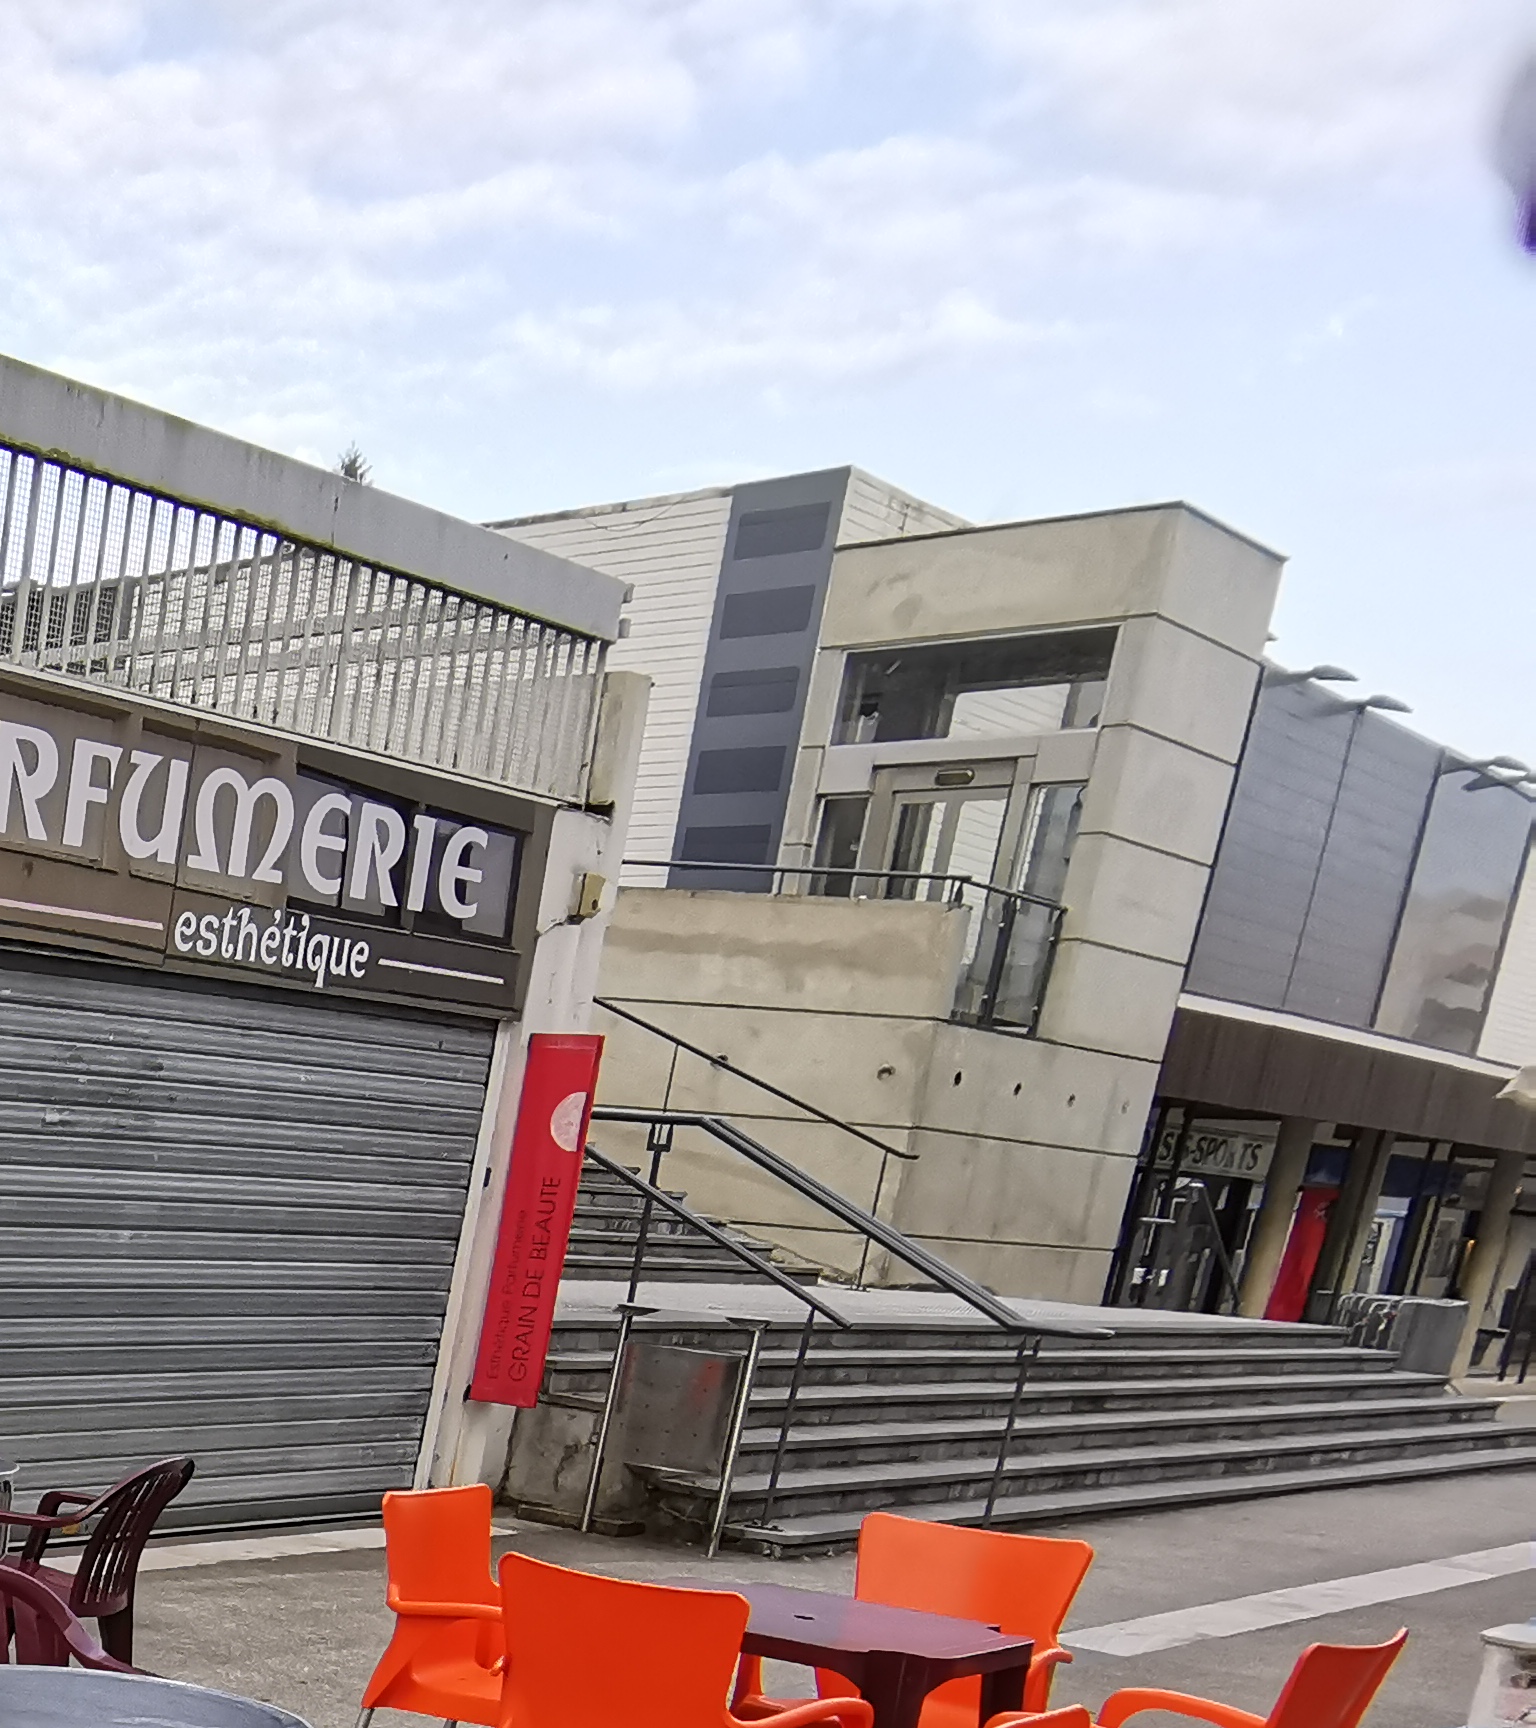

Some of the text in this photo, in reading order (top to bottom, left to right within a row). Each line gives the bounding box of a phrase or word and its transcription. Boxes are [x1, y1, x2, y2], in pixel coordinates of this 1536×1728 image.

[173, 906, 371, 987] esthétique
[507, 1176, 560, 1383] GRAIN DE BEAUTE
